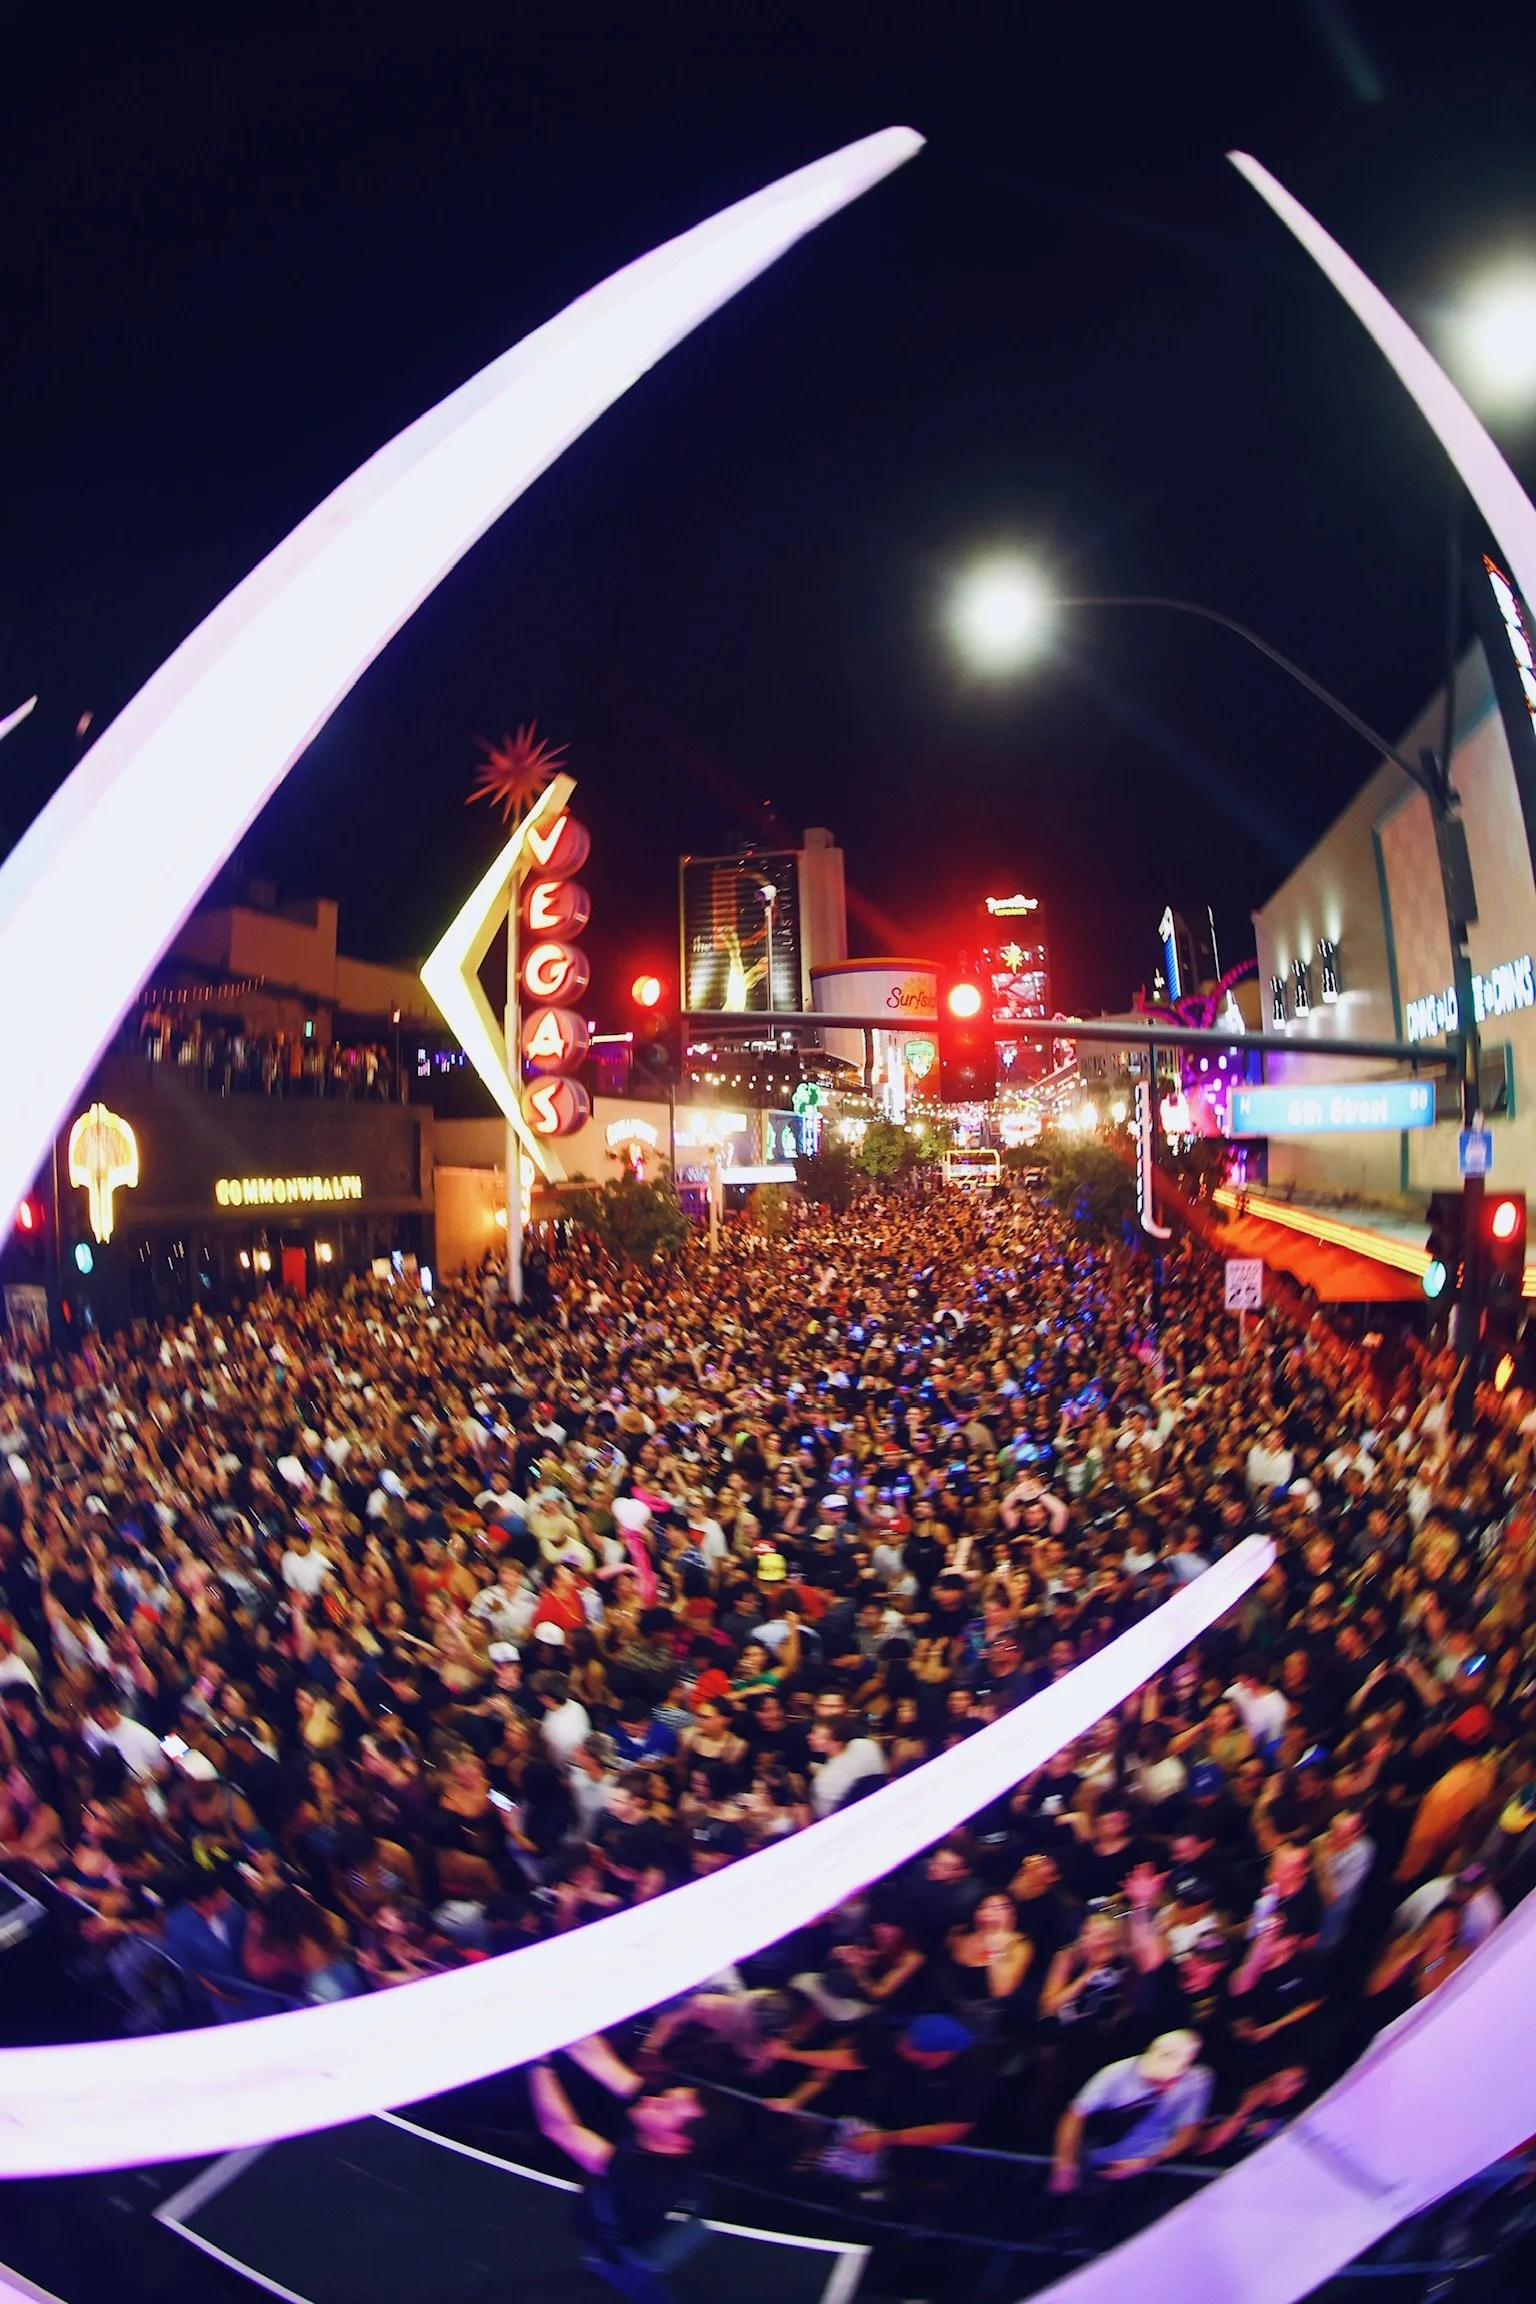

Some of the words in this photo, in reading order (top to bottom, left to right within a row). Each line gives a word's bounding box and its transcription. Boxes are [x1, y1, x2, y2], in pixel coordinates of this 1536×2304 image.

[781, 918, 793, 946] LAS
[525, 815, 574, 1134] VEGAS
[1330, 1095, 1388, 1125] Street
[215, 1174, 363, 1207] COMMONWEALTH
